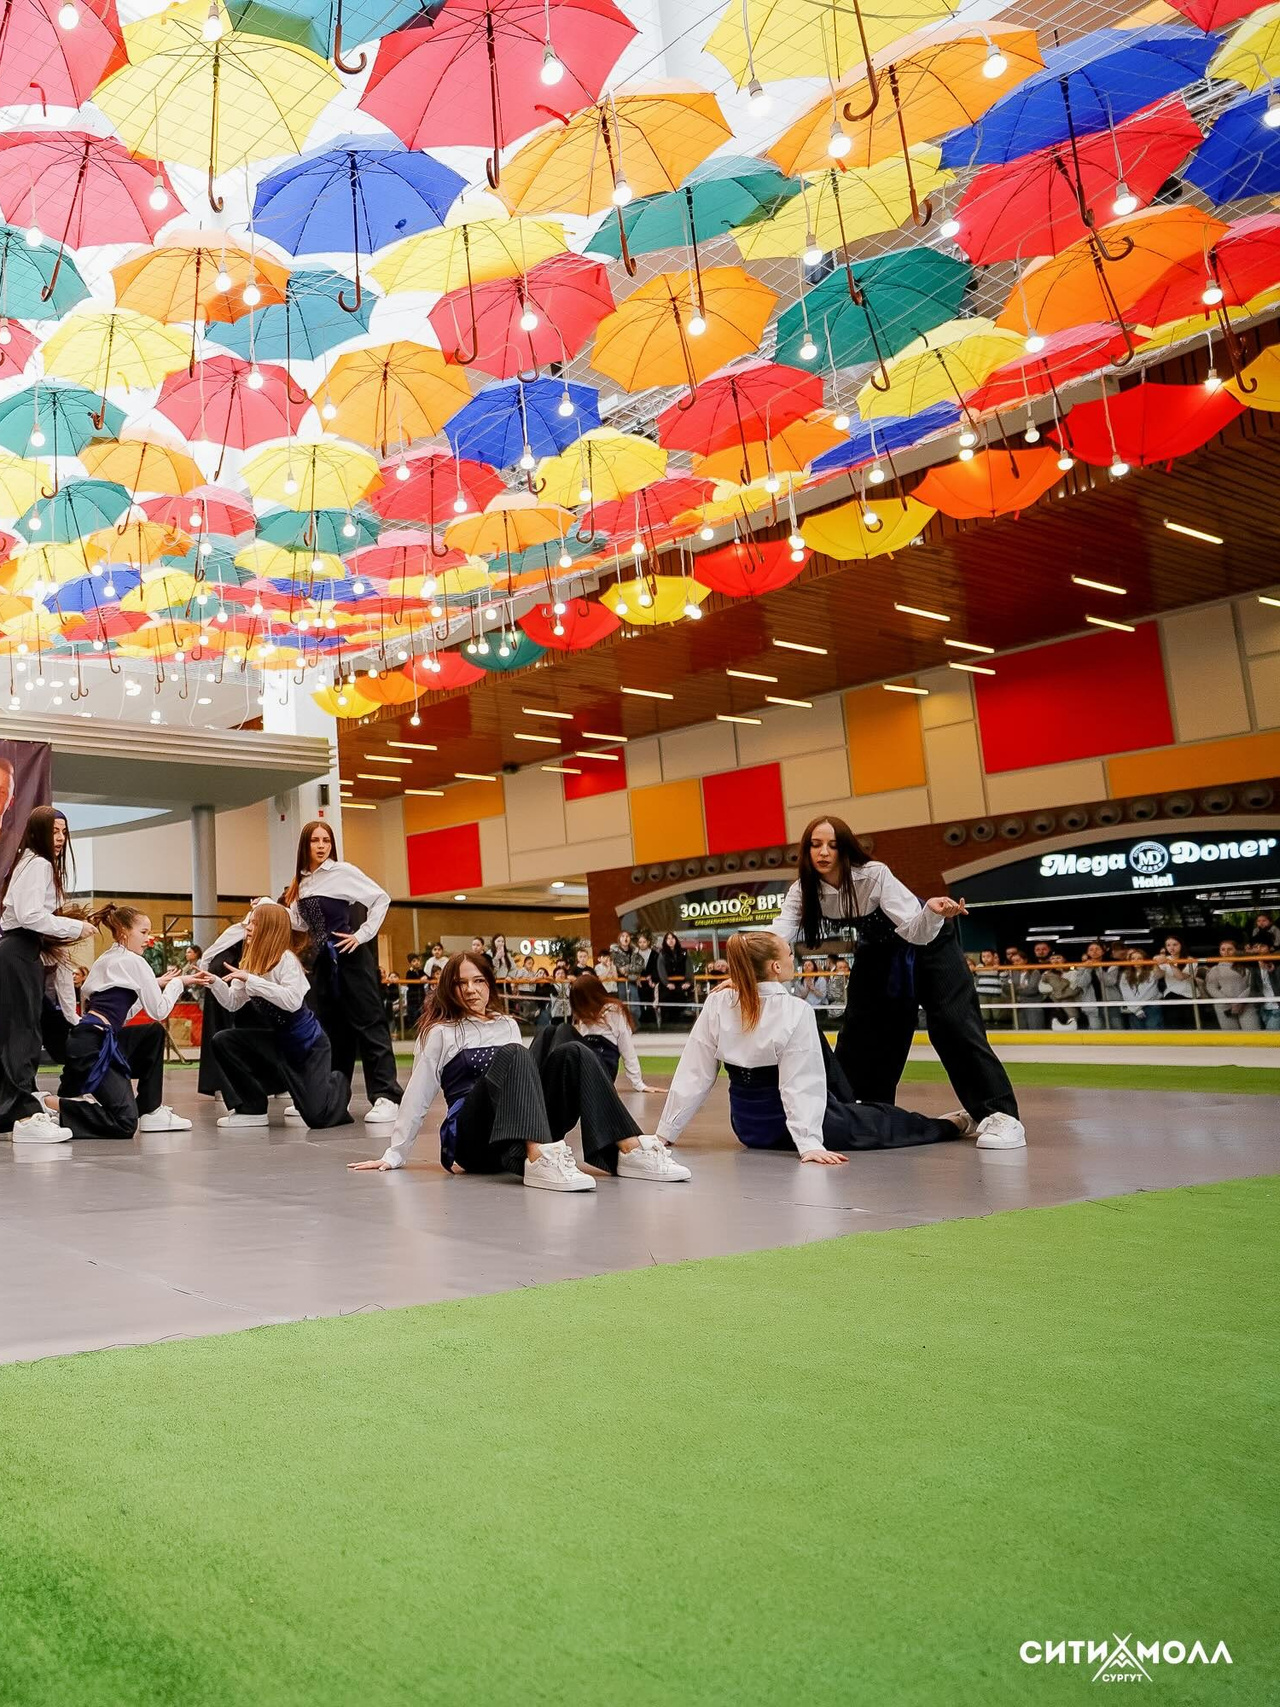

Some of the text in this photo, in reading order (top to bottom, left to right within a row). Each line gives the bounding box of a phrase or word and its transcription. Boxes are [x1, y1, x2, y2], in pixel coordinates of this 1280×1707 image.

[1040, 853, 1126, 877] Mega
[1170, 838, 1277, 864] Doner
[1132, 873, 1174, 889] Halal
[680, 899, 741, 918] ЗОЛОТО
